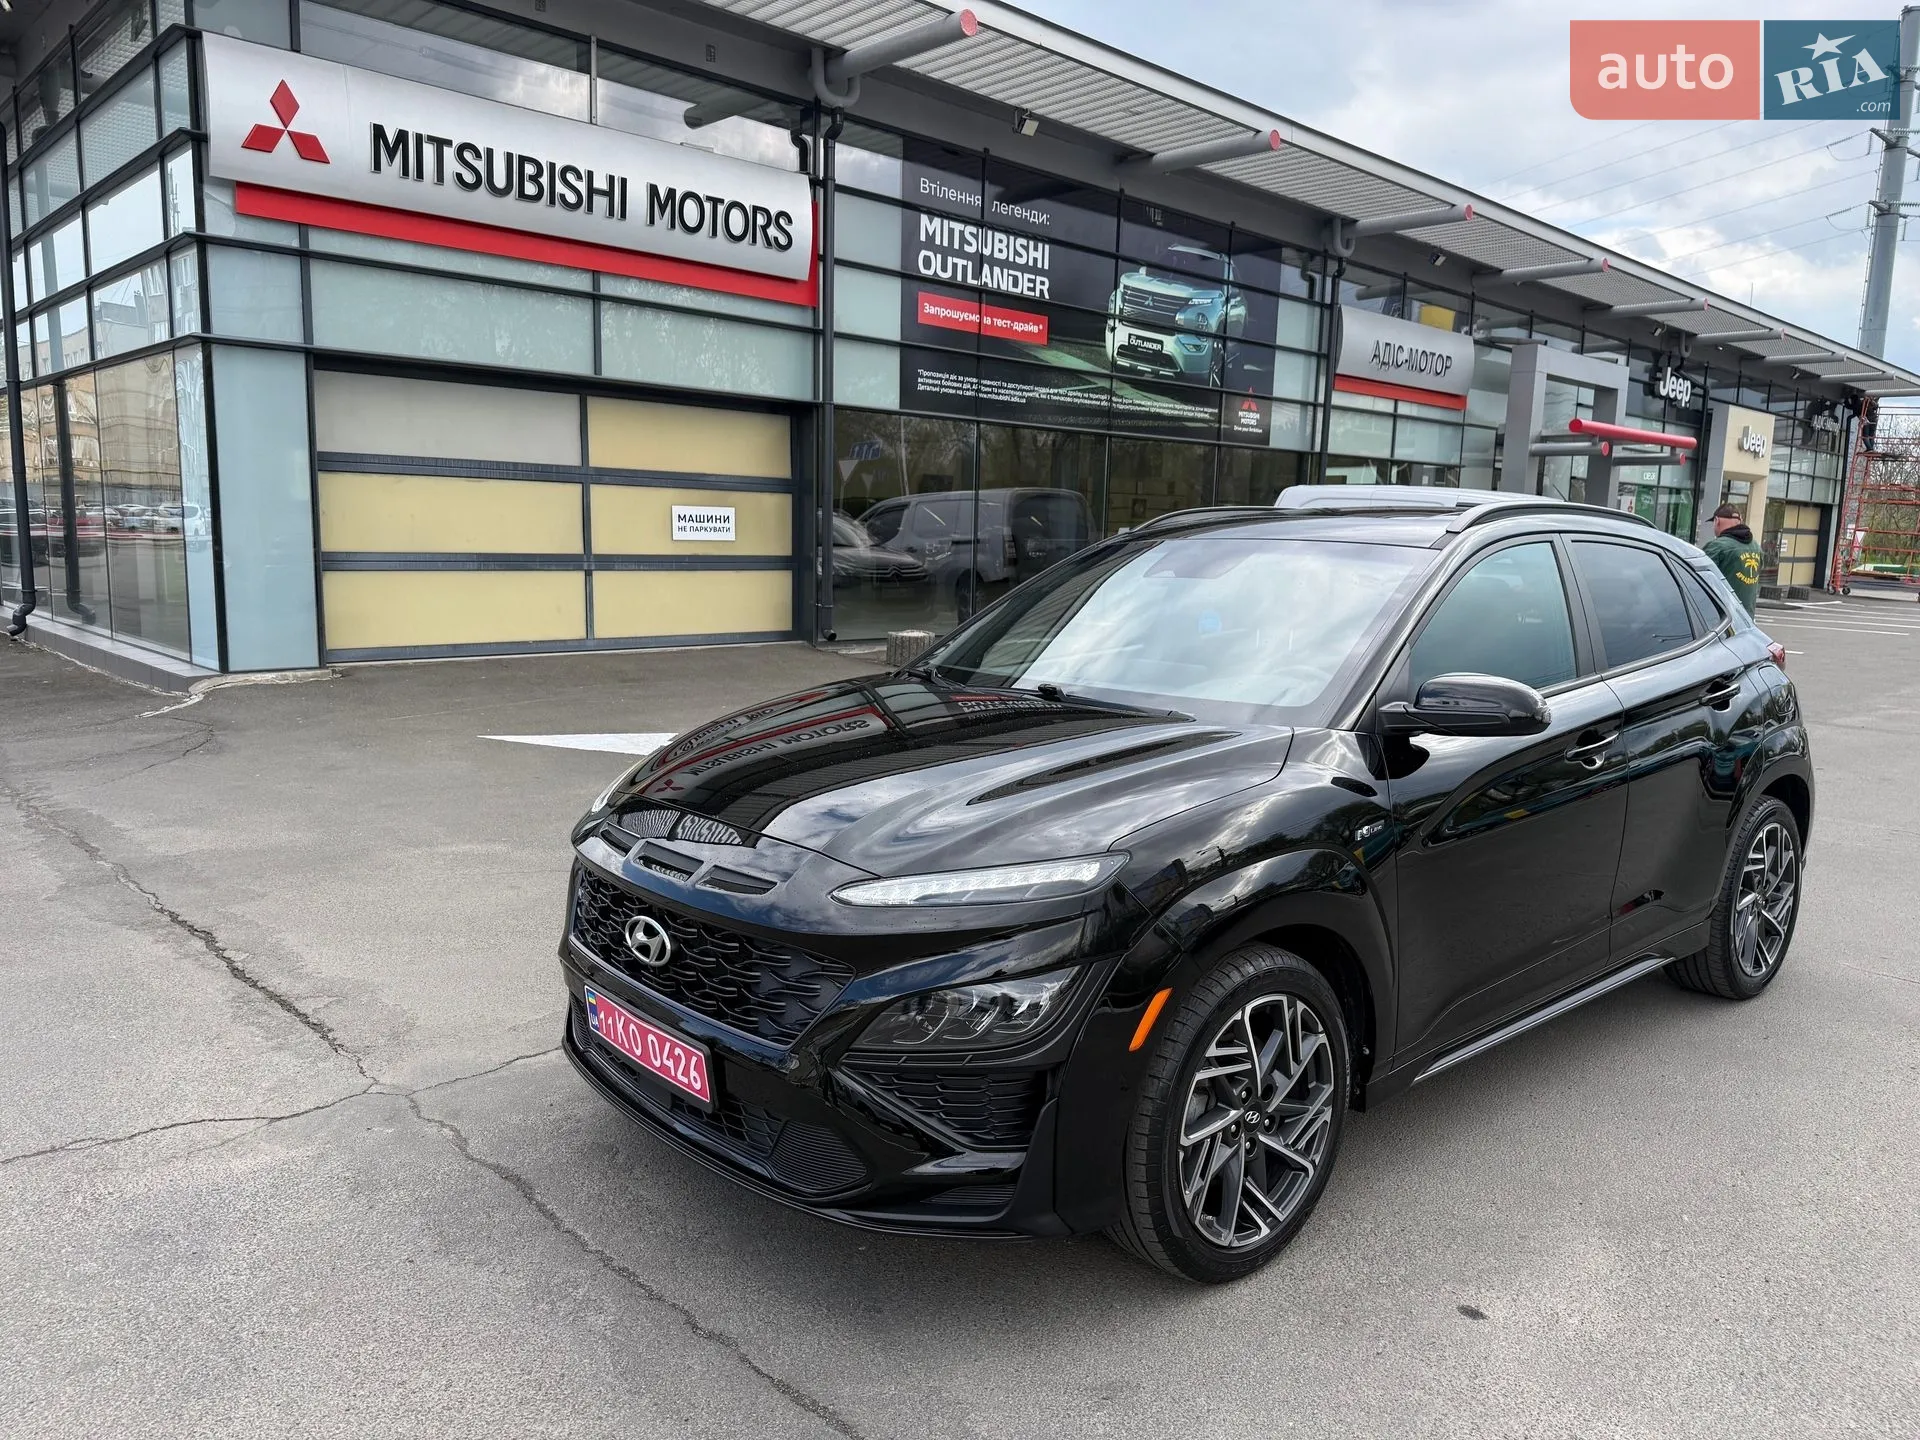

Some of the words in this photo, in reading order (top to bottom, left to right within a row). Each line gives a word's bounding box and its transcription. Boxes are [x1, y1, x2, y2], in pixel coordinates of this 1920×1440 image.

[370, 122, 627, 220] MITSUBISHI
[647, 182, 793, 251] MOTORS
[920, 177, 982, 207] Втілення
[992, 200, 1050, 225] легенди:
[920, 213, 1050, 270] MITSUBISHI
[918, 249, 1050, 299] OUTLANDER
[923, 302, 980, 322] Запрошуємо
[1130, 339, 1162, 351] OUTLANDER
[1369, 339, 1453, 377] АДІС-МОТОР
[1660, 367, 1691, 407] Jeep
[1743, 425, 1767, 458] Jeep
[677, 513, 730, 524] МАШИНИ
[677, 525, 688, 533] НЕ
[689, 525, 731, 533] ПАРКУВАТИ
[590, 1013, 599, 1027] UA
[600, 1010, 642, 1057] 11KO
[647, 1033, 702, 1090] 0426
